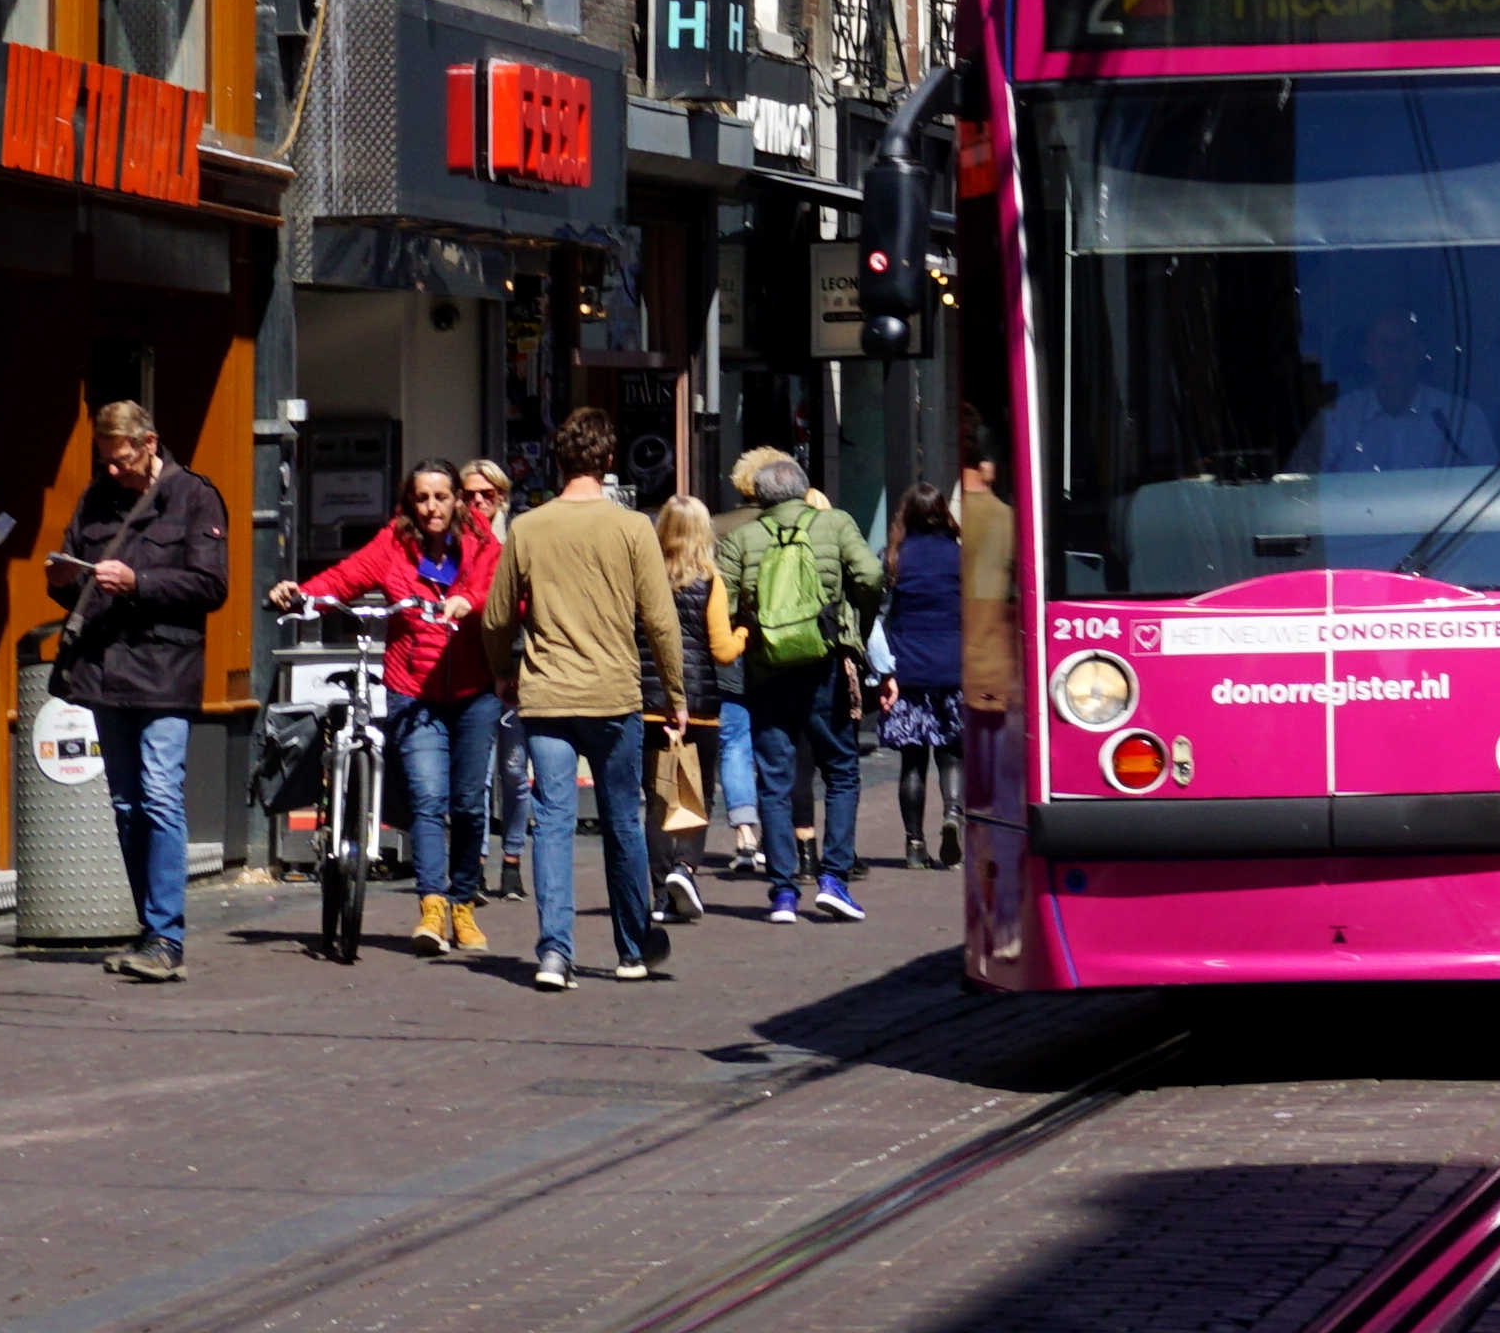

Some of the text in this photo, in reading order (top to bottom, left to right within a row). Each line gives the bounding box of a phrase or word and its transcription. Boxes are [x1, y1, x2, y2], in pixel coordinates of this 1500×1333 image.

[820, 276, 860, 292] LEON
[1053, 617, 1122, 640] 2104
[1211, 673, 1450, 706] donorregister.nl
